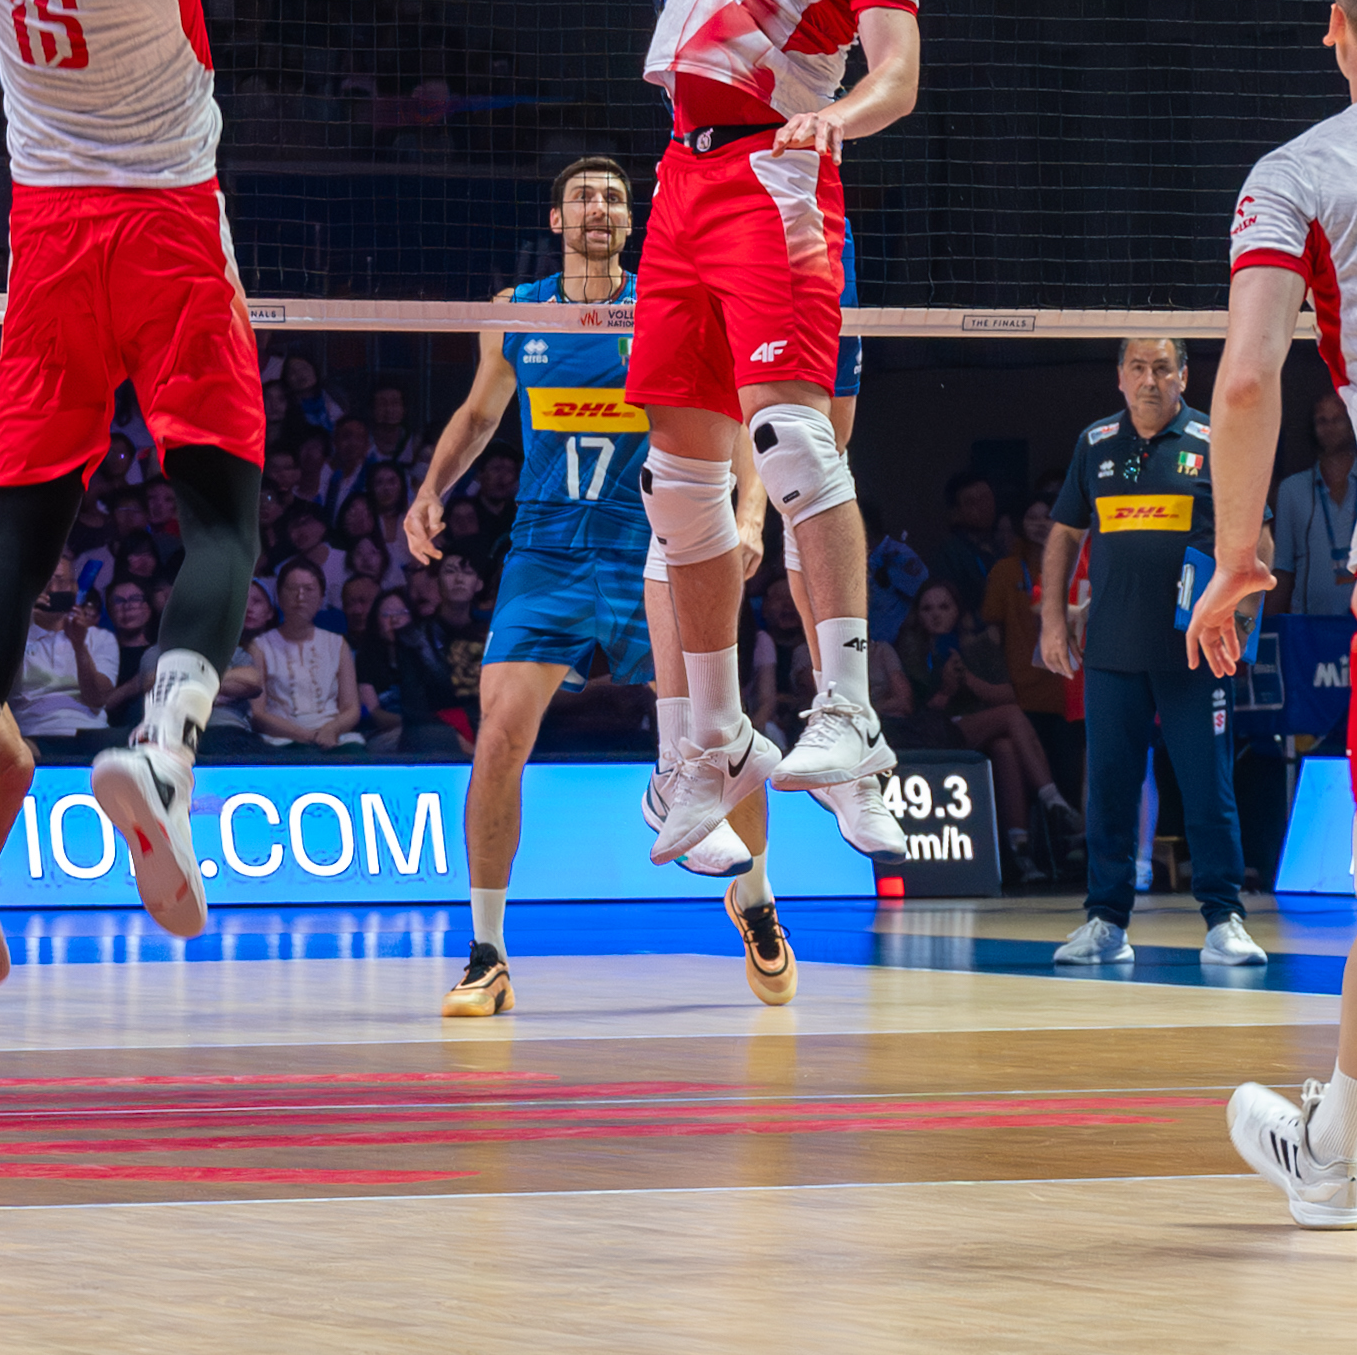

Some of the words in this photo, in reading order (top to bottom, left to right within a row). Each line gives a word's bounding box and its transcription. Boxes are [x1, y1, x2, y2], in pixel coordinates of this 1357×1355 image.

[250, 309, 277, 319] NALS
[580, 309, 603, 327] VNL
[971, 319, 988, 327] THE
[992, 319, 1027, 328] FINALS
[549, 402, 621, 418] DHL
[565, 435, 616, 501] 17
[1177, 464, 1199, 477] ITA
[1114, 506, 1169, 519] DHL
